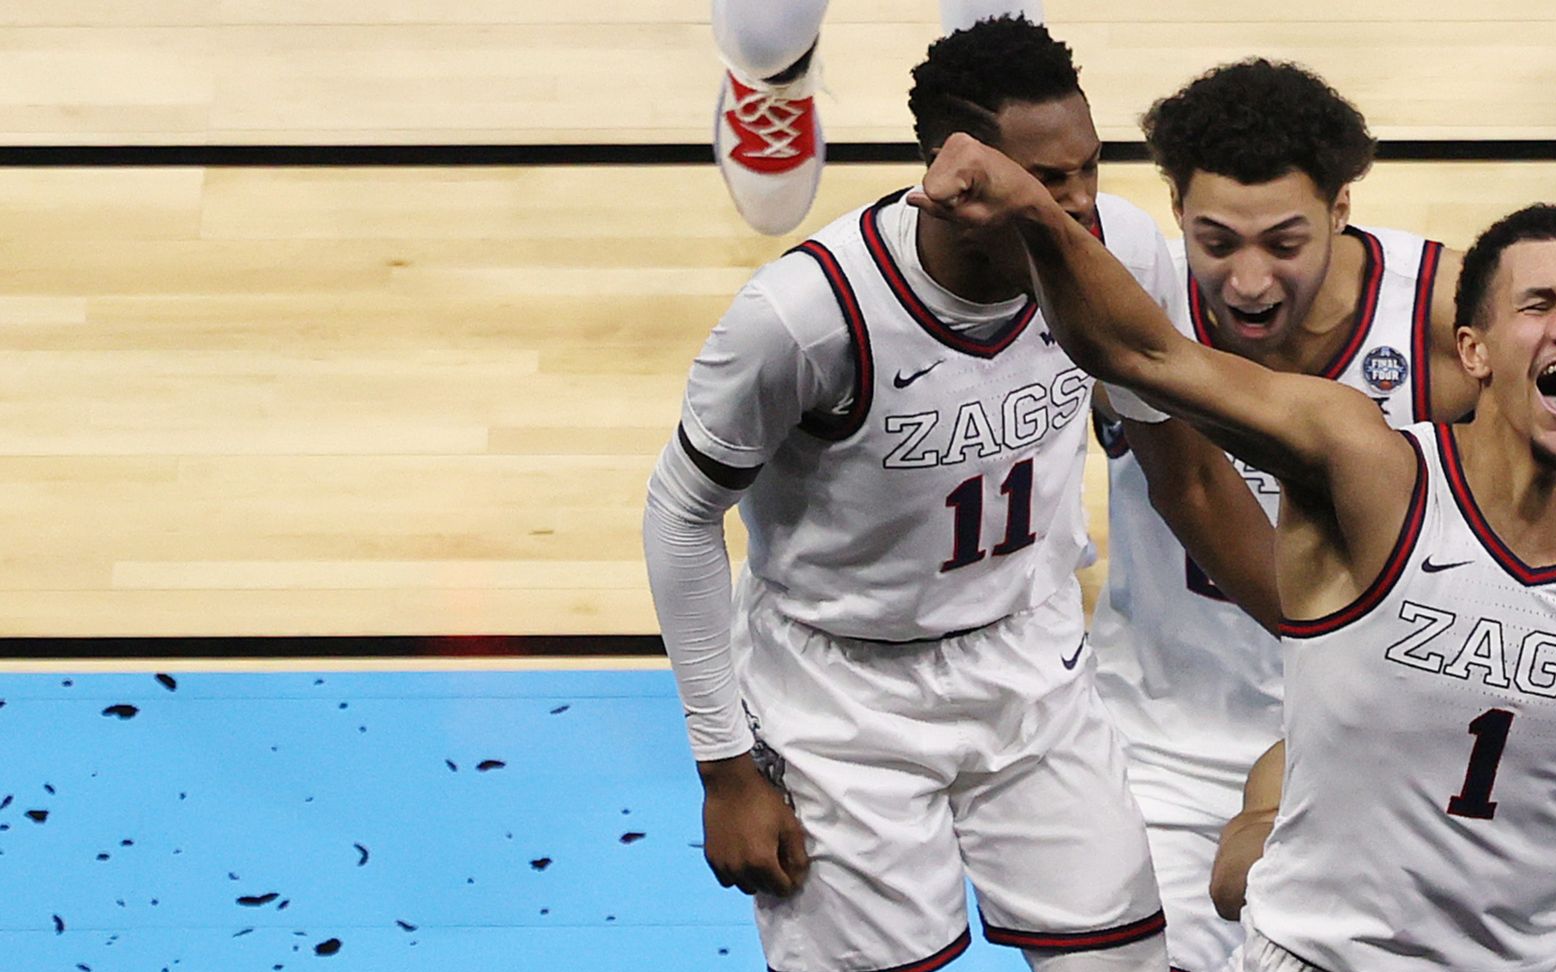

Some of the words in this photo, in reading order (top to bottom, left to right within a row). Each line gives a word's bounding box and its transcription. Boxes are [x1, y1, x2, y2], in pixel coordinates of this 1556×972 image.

[1372, 359, 1400, 369] FINAL
[1372, 370, 1399, 380] FOUR
[883, 367, 1089, 469] ZAGS
[940, 457, 1036, 573] 11
[1447, 708, 1515, 820] 1
